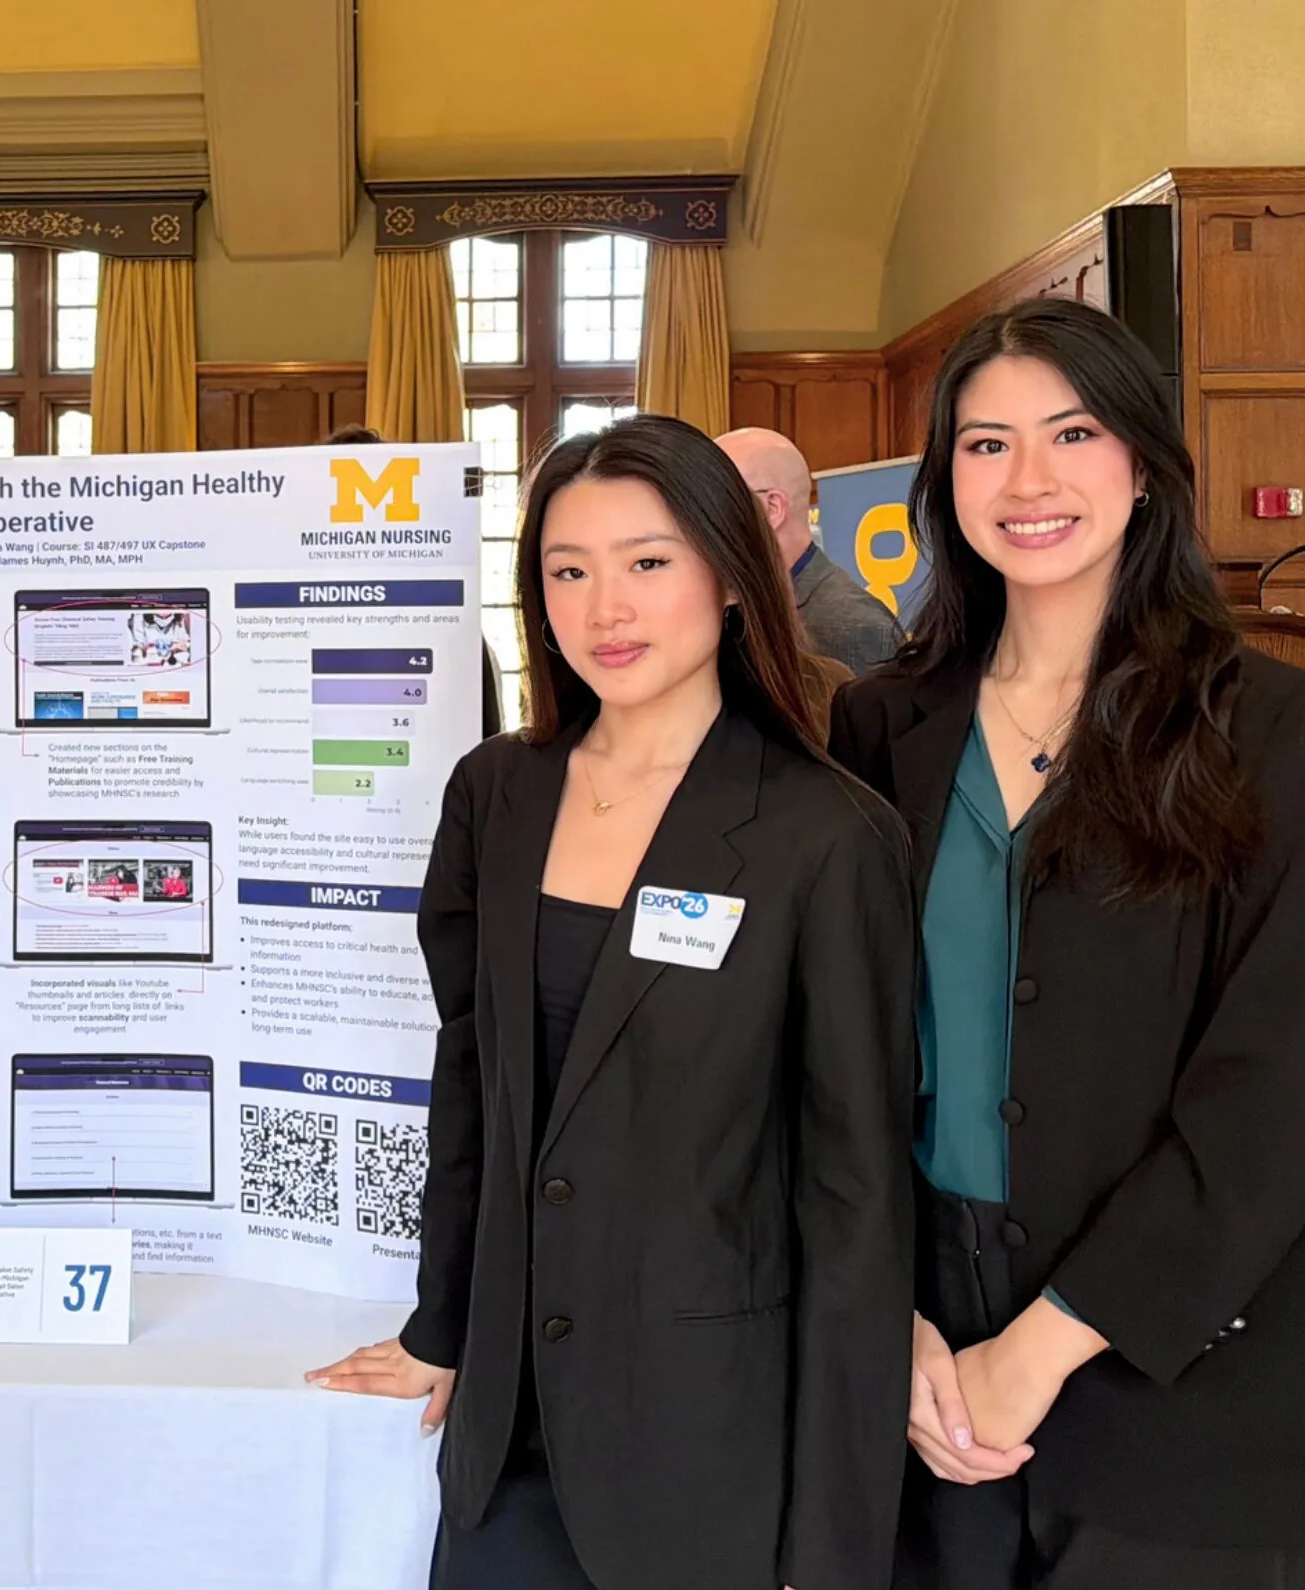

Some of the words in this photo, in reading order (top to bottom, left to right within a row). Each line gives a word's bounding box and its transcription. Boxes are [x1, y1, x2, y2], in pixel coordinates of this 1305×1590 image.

[21, 476, 62, 498] the
[70, 475, 184, 502] Michigan
[193, 471, 285, 497] Healthy
[301, 531, 376, 545] MICHIGAN
[381, 530, 452, 544] NURSING
[5, 542, 35, 554] Wang
[41, 542, 81, 552] Course:
[84, 541, 95, 551] SI
[97, 540, 139, 550] 487/497
[141, 540, 156, 550] UX
[158, 540, 206, 551] Capstone
[31, 556, 67, 567] Huynh,
[69, 555, 93, 566] PhD,
[95, 555, 116, 565] MA,
[118, 554, 143, 564] MPH
[308, 550, 370, 560] UNIVERSITY
[372, 550, 385, 558] OF
[387, 550, 443, 558] MICHIGAN
[299, 585, 386, 602] FINDINGS
[236, 616, 273, 626] Usability
[275, 616, 305, 626] testing
[307, 615, 345, 624] revealed
[347, 615, 363, 626] key
[365, 615, 410, 625] strengths
[412, 614, 431, 623] and
[433, 615, 460, 623] areas
[409, 656, 427, 666] 4.2
[403, 688, 422, 697] 4.0
[393, 718, 410, 727] 3.6
[48, 743, 82, 752] Created
[83, 744, 101, 752] new
[103, 744, 139, 752] sections
[141, 744, 152, 752] on
[153, 744, 168, 752] the
[386, 747, 404, 756] 3.4
[355, 779, 371, 788] 2.2
[238, 816, 255, 826] Key
[257, 816, 289, 827] Insight:
[238, 830, 263, 840] While
[264, 832, 288, 840] users
[290, 831, 316, 842] found
[317, 833, 332, 842] the
[334, 834, 351, 843] site
[352, 836, 375, 846] easy
[376, 835, 387, 844] to
[388, 837, 406, 845] use
[311, 887, 382, 906] IMPACT
[240, 916, 259, 926] This
[260, 919, 310, 930] redesigned
[311, 922, 353, 932] platform:
[658, 932, 682, 945] Nina
[685, 936, 716, 952] Wang
[303, 1072, 328, 1091] QR
[332, 1075, 392, 1097] CODES
[248, 1225, 289, 1239] MHNSC
[291, 1230, 333, 1246] Website
[372, 1244, 422, 1262] Presenta
[13, 1266, 34, 1274] Safety
[63, 1264, 112, 1312] 37
